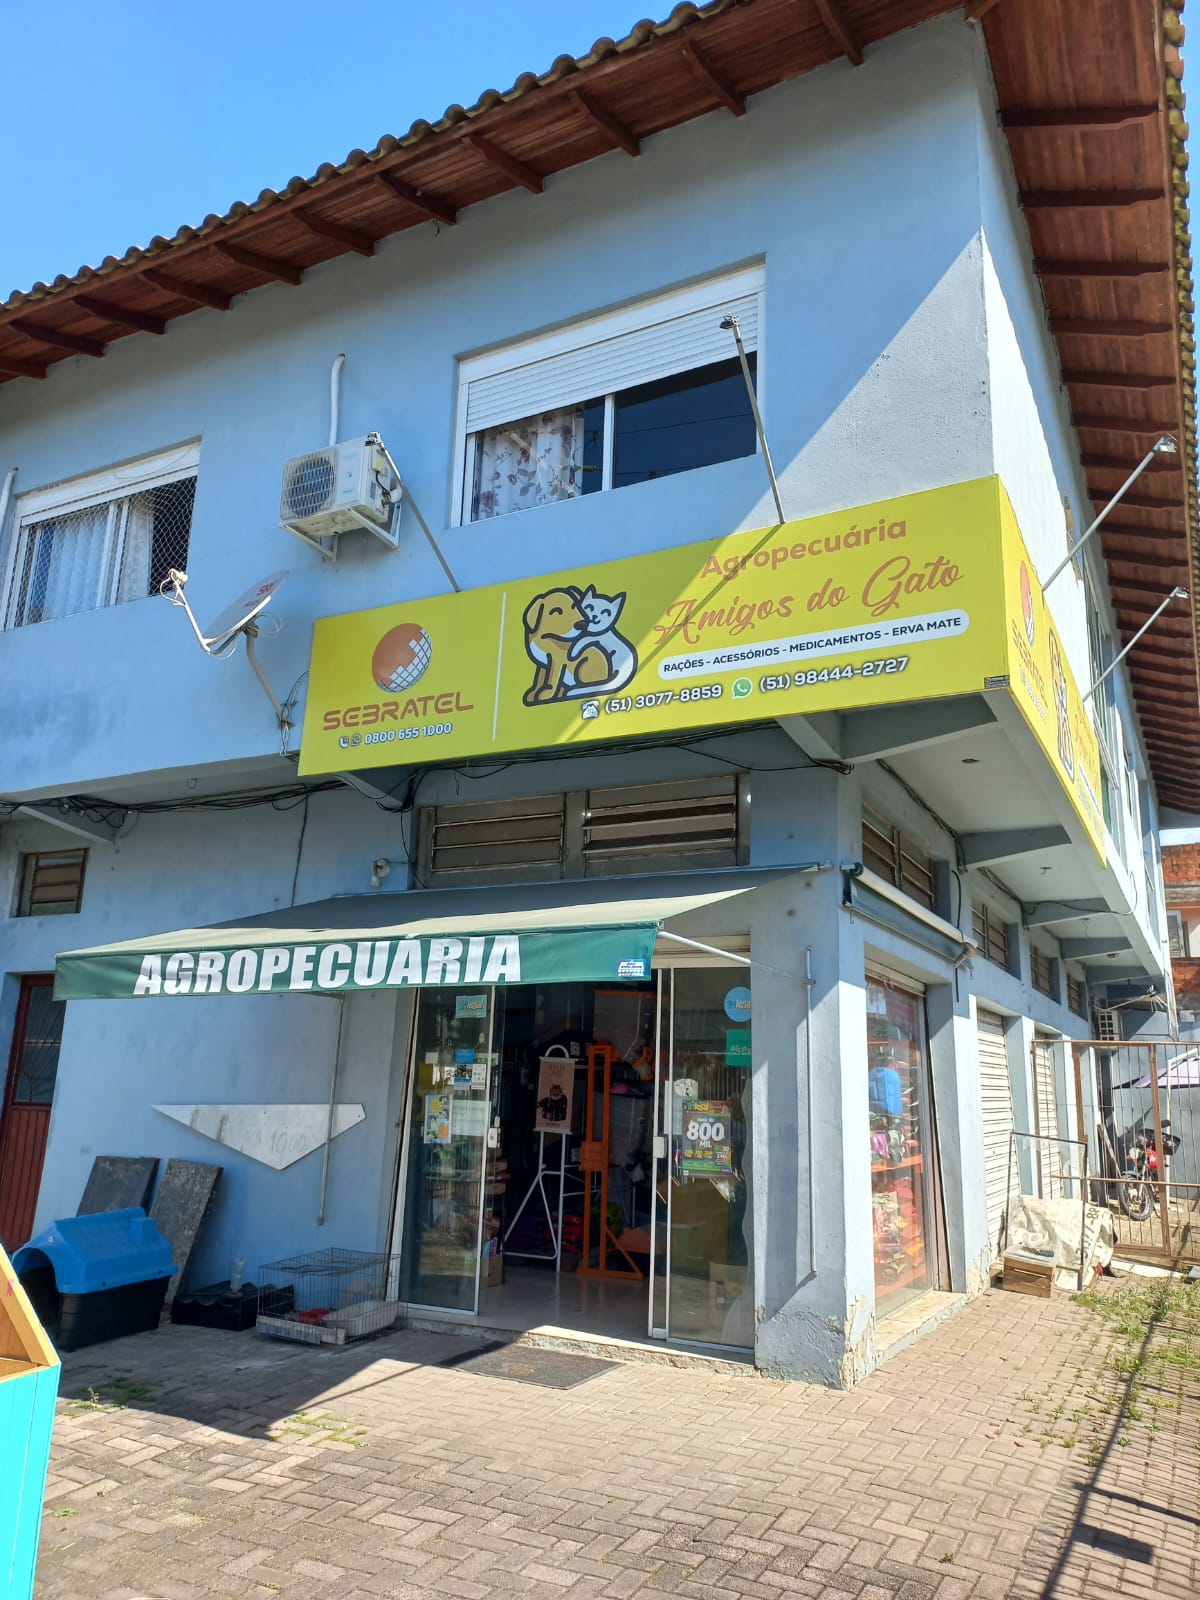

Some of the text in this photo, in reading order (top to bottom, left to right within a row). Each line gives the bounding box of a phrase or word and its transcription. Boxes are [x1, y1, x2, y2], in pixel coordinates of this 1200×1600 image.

[700, 518, 907, 581] Agropecuária
[652, 555, 965, 645] Amigos do Gato
[663, 658, 704, 674] RAÇÕES
[712, 647, 780, 665] ACESSÓRIOS
[789, 630, 881, 653] MEDICAMENTOS
[892, 623, 925, 638] ERVA
[926, 616, 962, 633] MATE
[759, 656, 910, 694] (51) 98444-2727
[322, 691, 475, 732] SEBRATEL
[605, 684, 723, 714] (51) 3077-8859
[364, 722, 453, 745] 0800 655 1000
[686, 1121, 725, 1142] 800
